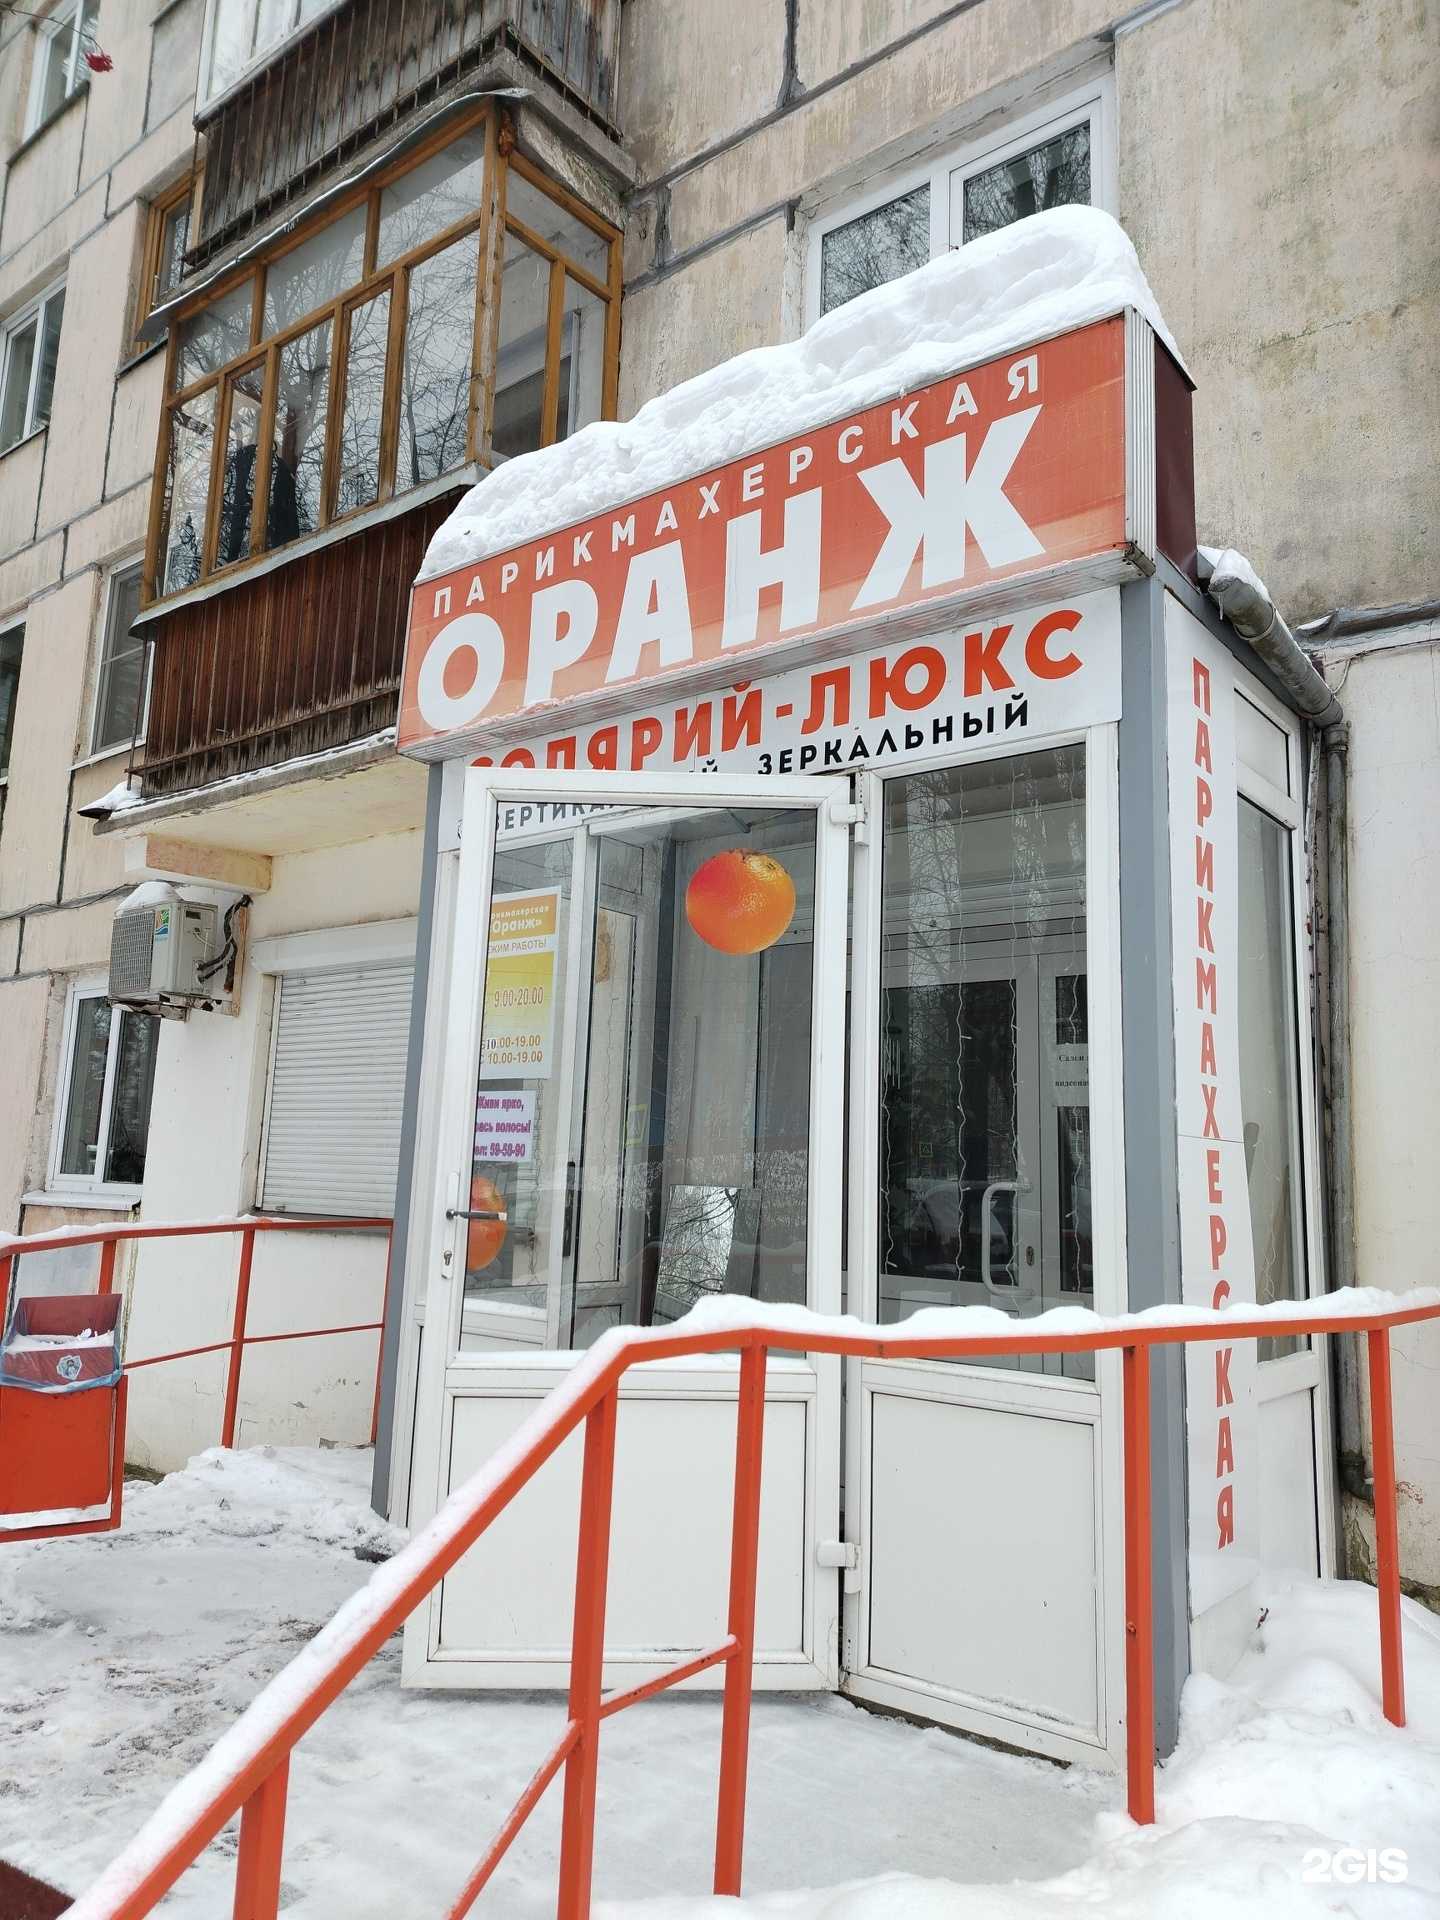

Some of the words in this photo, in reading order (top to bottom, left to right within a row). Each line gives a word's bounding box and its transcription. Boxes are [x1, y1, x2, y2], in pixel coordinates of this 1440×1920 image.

[433, 354, 1039, 618] ПАРИКМАХЕРСКАЯ
[417, 404, 1046, 731] ОРАНЖ
[470, 608, 1084, 770] ЛЯРИЙ-ЛЮКС
[758, 693, 1029, 775] ЗЕРКАЛЬНЫЙ
[512, 936, 546, 952] РАБОТЫ
